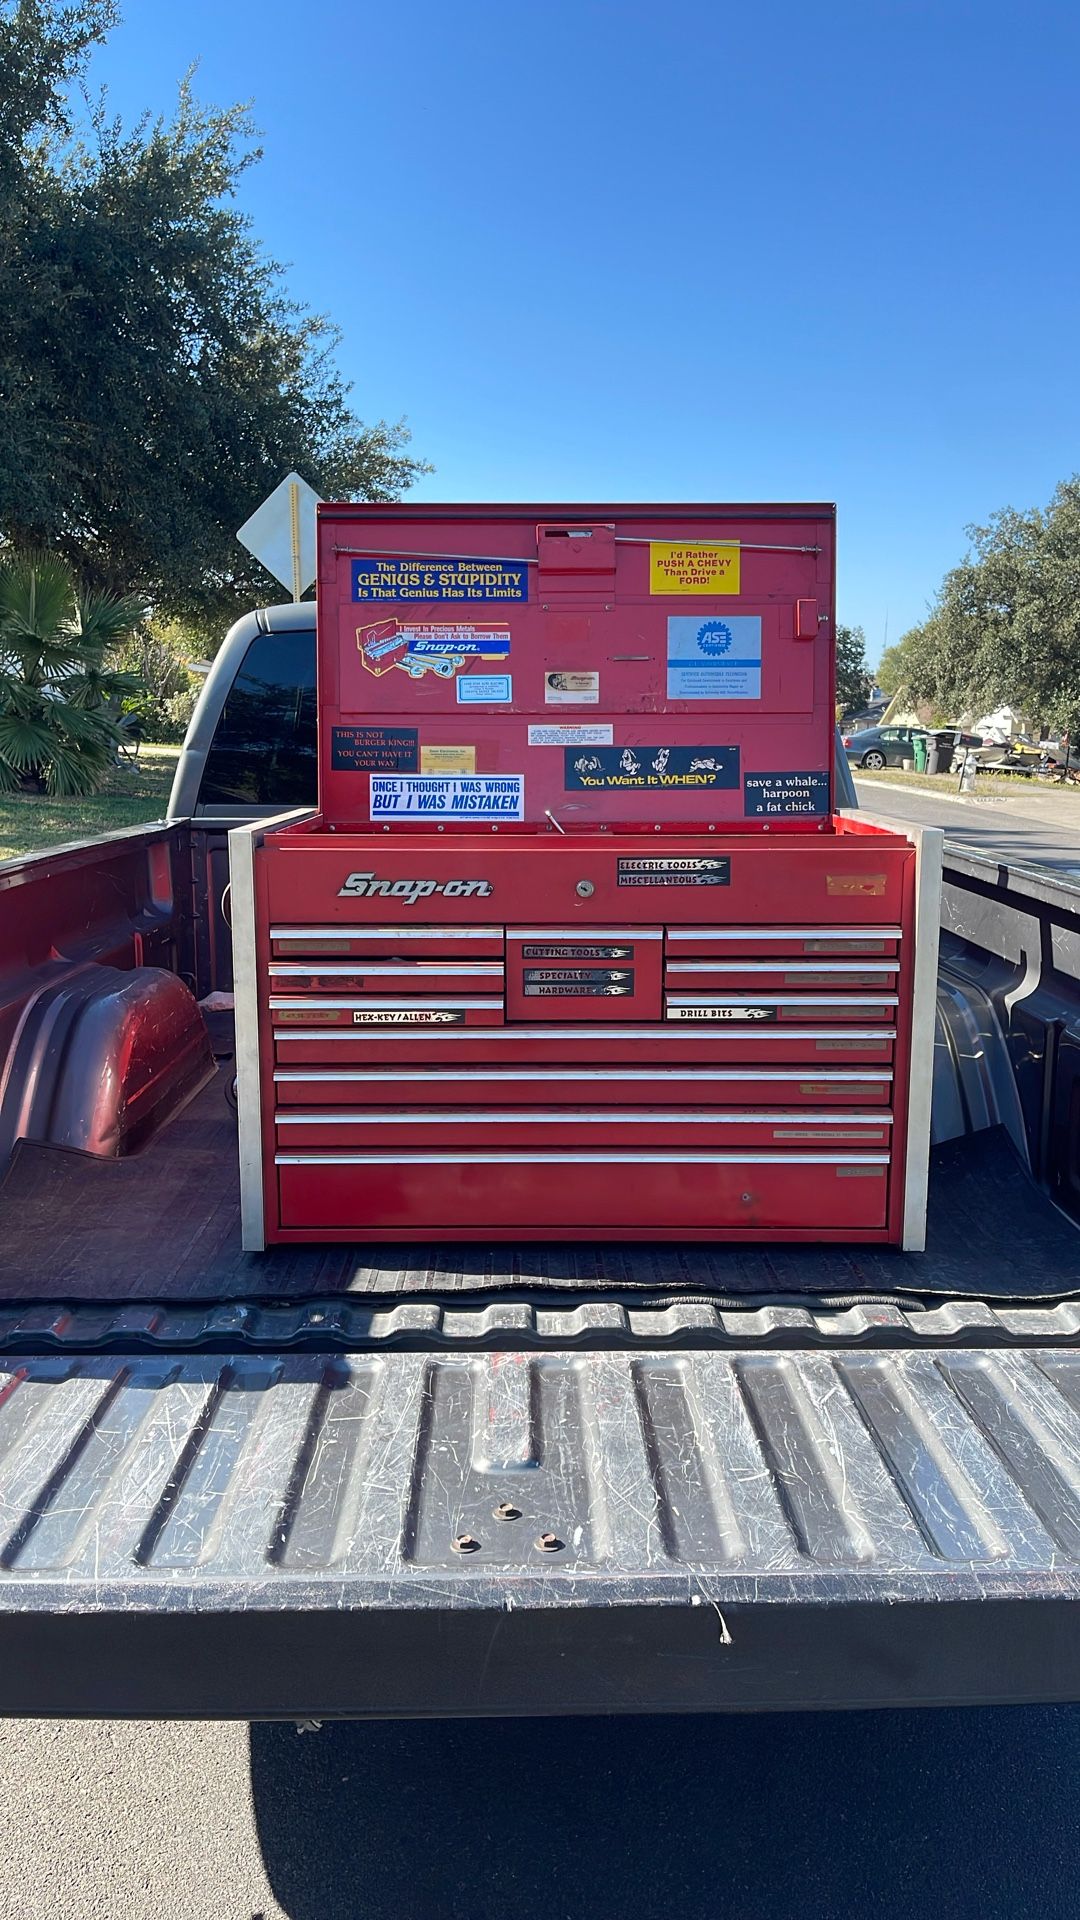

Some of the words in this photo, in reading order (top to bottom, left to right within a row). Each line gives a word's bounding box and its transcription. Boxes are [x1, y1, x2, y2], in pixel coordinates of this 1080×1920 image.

[376, 562, 396, 572] The
[400, 562, 454, 572] Difference
[458, 562, 503, 572] Between
[657, 560, 684, 568] PUSH
[357, 573, 420, 586] GENIUS
[423, 573, 435, 586] &
[438, 573, 522, 586] STUPIDITY
[358, 587, 368, 598] Is
[371, 587, 396, 598] That
[400, 587, 439, 598] Genius
[442, 587, 464, 598] Has
[467, 587, 482, 598] Its
[485, 587, 522, 598] Limits
[701, 632, 726, 643] ASE
[414, 641, 477, 654] Snap-on
[579, 776, 604, 786] You
[606, 775, 645, 785] Want
[647, 775, 658, 785] It
[658, 774, 716, 785] WHEN?
[746, 780, 772, 788] save
[372, 781, 397, 792] ONCE
[400, 781, 404, 792] I
[406, 781, 450, 792] THOUGHT
[453, 782, 457, 792] I
[460, 782, 481, 792] WAS
[485, 782, 520, 793] WRONG
[763, 788, 810, 799] harpoon
[373, 795, 401, 809] BUT
[406, 795, 413, 809] I
[418, 795, 445, 809] WAS
[451, 795, 519, 809] MISTAKEN
[756, 804, 763, 812] a
[766, 802, 781, 812] fat
[785, 801, 815, 812] chick
[620, 861, 664, 869] ELECTRIC
[667, 861, 697, 869] TOOLS
[620, 876, 697, 884] MISCELLANEOUS
[337, 872, 492, 905] Snap-on
[526, 948, 568, 956] CUTTING
[571, 948, 600, 956] TOOLS
[539, 972, 592, 980] SPECIALTY
[680, 1010, 708, 1018] DRILL
[711, 1010, 733, 1018] BITS
